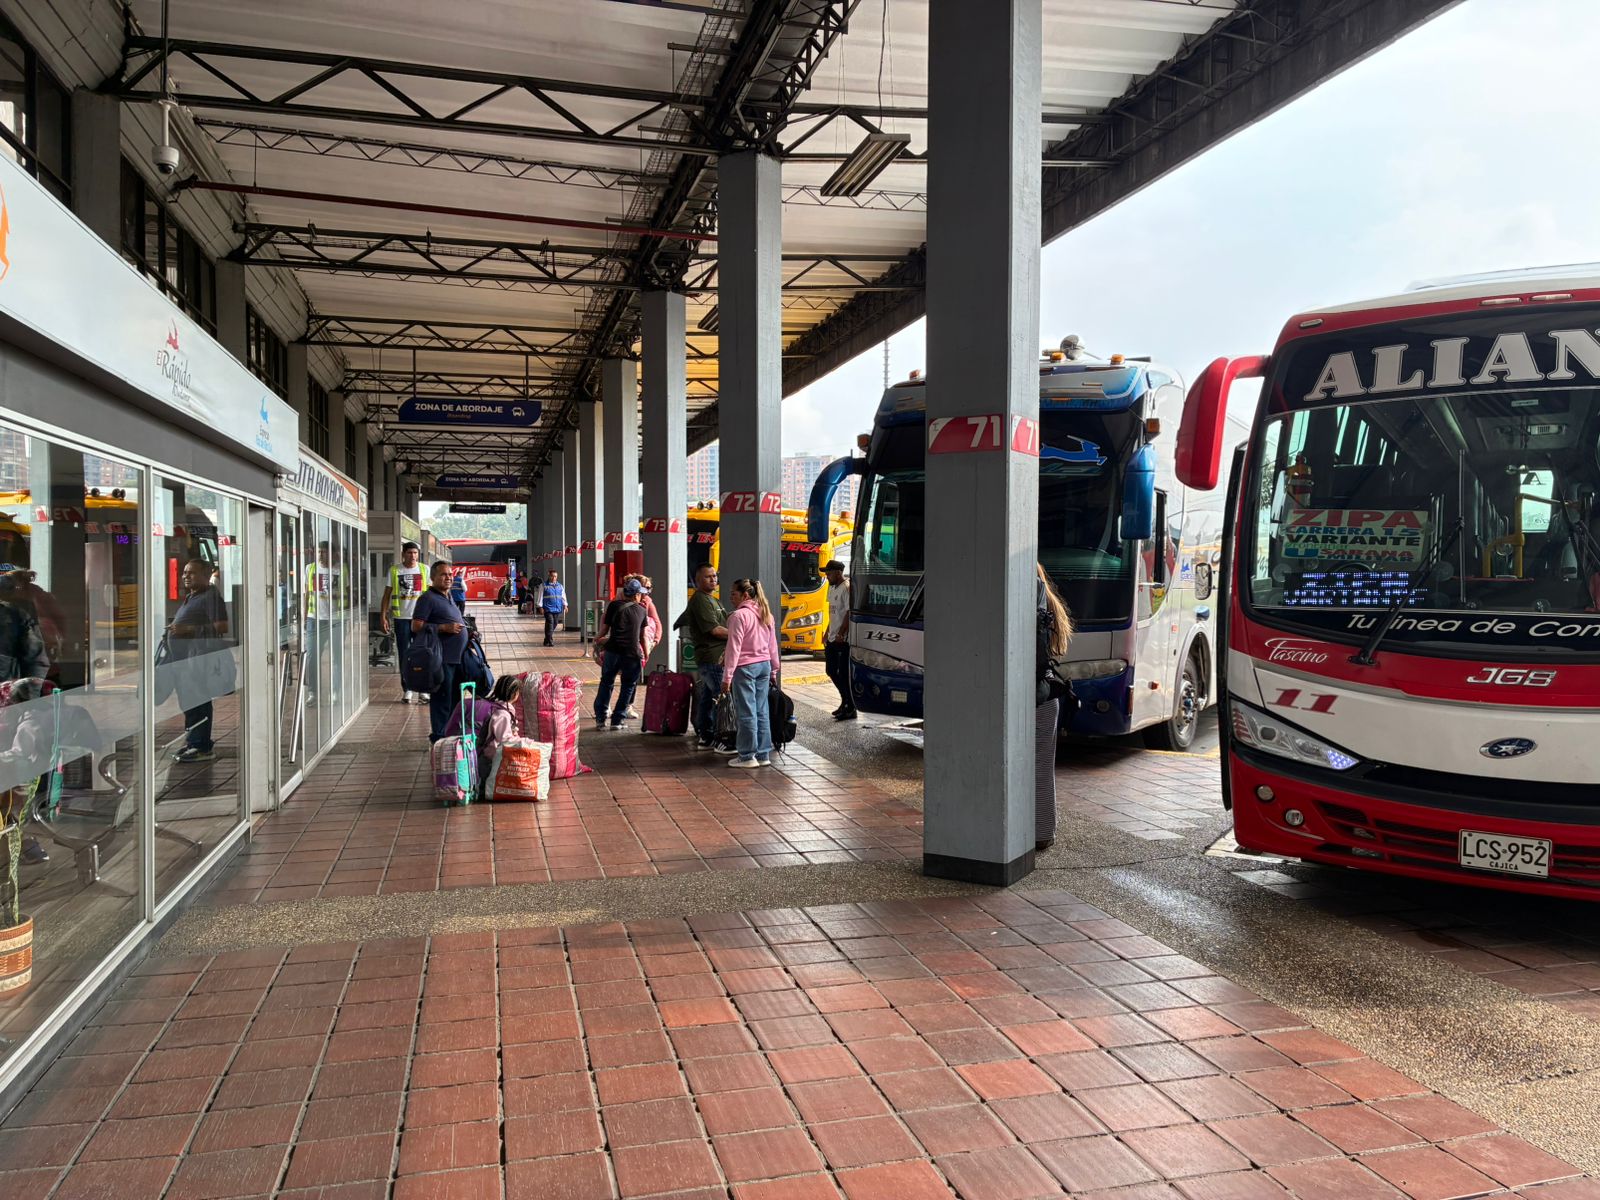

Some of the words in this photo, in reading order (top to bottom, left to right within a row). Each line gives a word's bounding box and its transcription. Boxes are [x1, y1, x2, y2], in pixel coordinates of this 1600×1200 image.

[162, 350, 191, 389] Rápido
[415, 403, 440, 411] ZONA
[442, 404, 454, 412] DE
[456, 405, 503, 413] ABORDAJE
[967, 415, 1000, 448] 71
[315, 472, 344, 508] BOYACA
[734, 492, 755, 511] 72
[768, 494, 781, 512] 72
[652, 519, 666, 531] 73
[1292, 510, 1422, 528] ZIPA
[611, 532, 621, 542] 74
[630, 532, 638, 543] 74
[1285, 526, 1374, 535] CARRERA
[1383, 528, 1420, 537] 15
[1287, 535, 1420, 546] VARIANTE
[1347, 614, 1375, 629] Tu
[1389, 614, 1462, 633] inea
[1469, 617, 1516, 634] de
[1528, 620, 1600, 637] Con
[864, 630, 900, 642] 142
[1264, 637, 1332, 664] Fascino
[1266, 688, 1340, 715] 11
[1489, 860, 1519, 870] CAJICA
